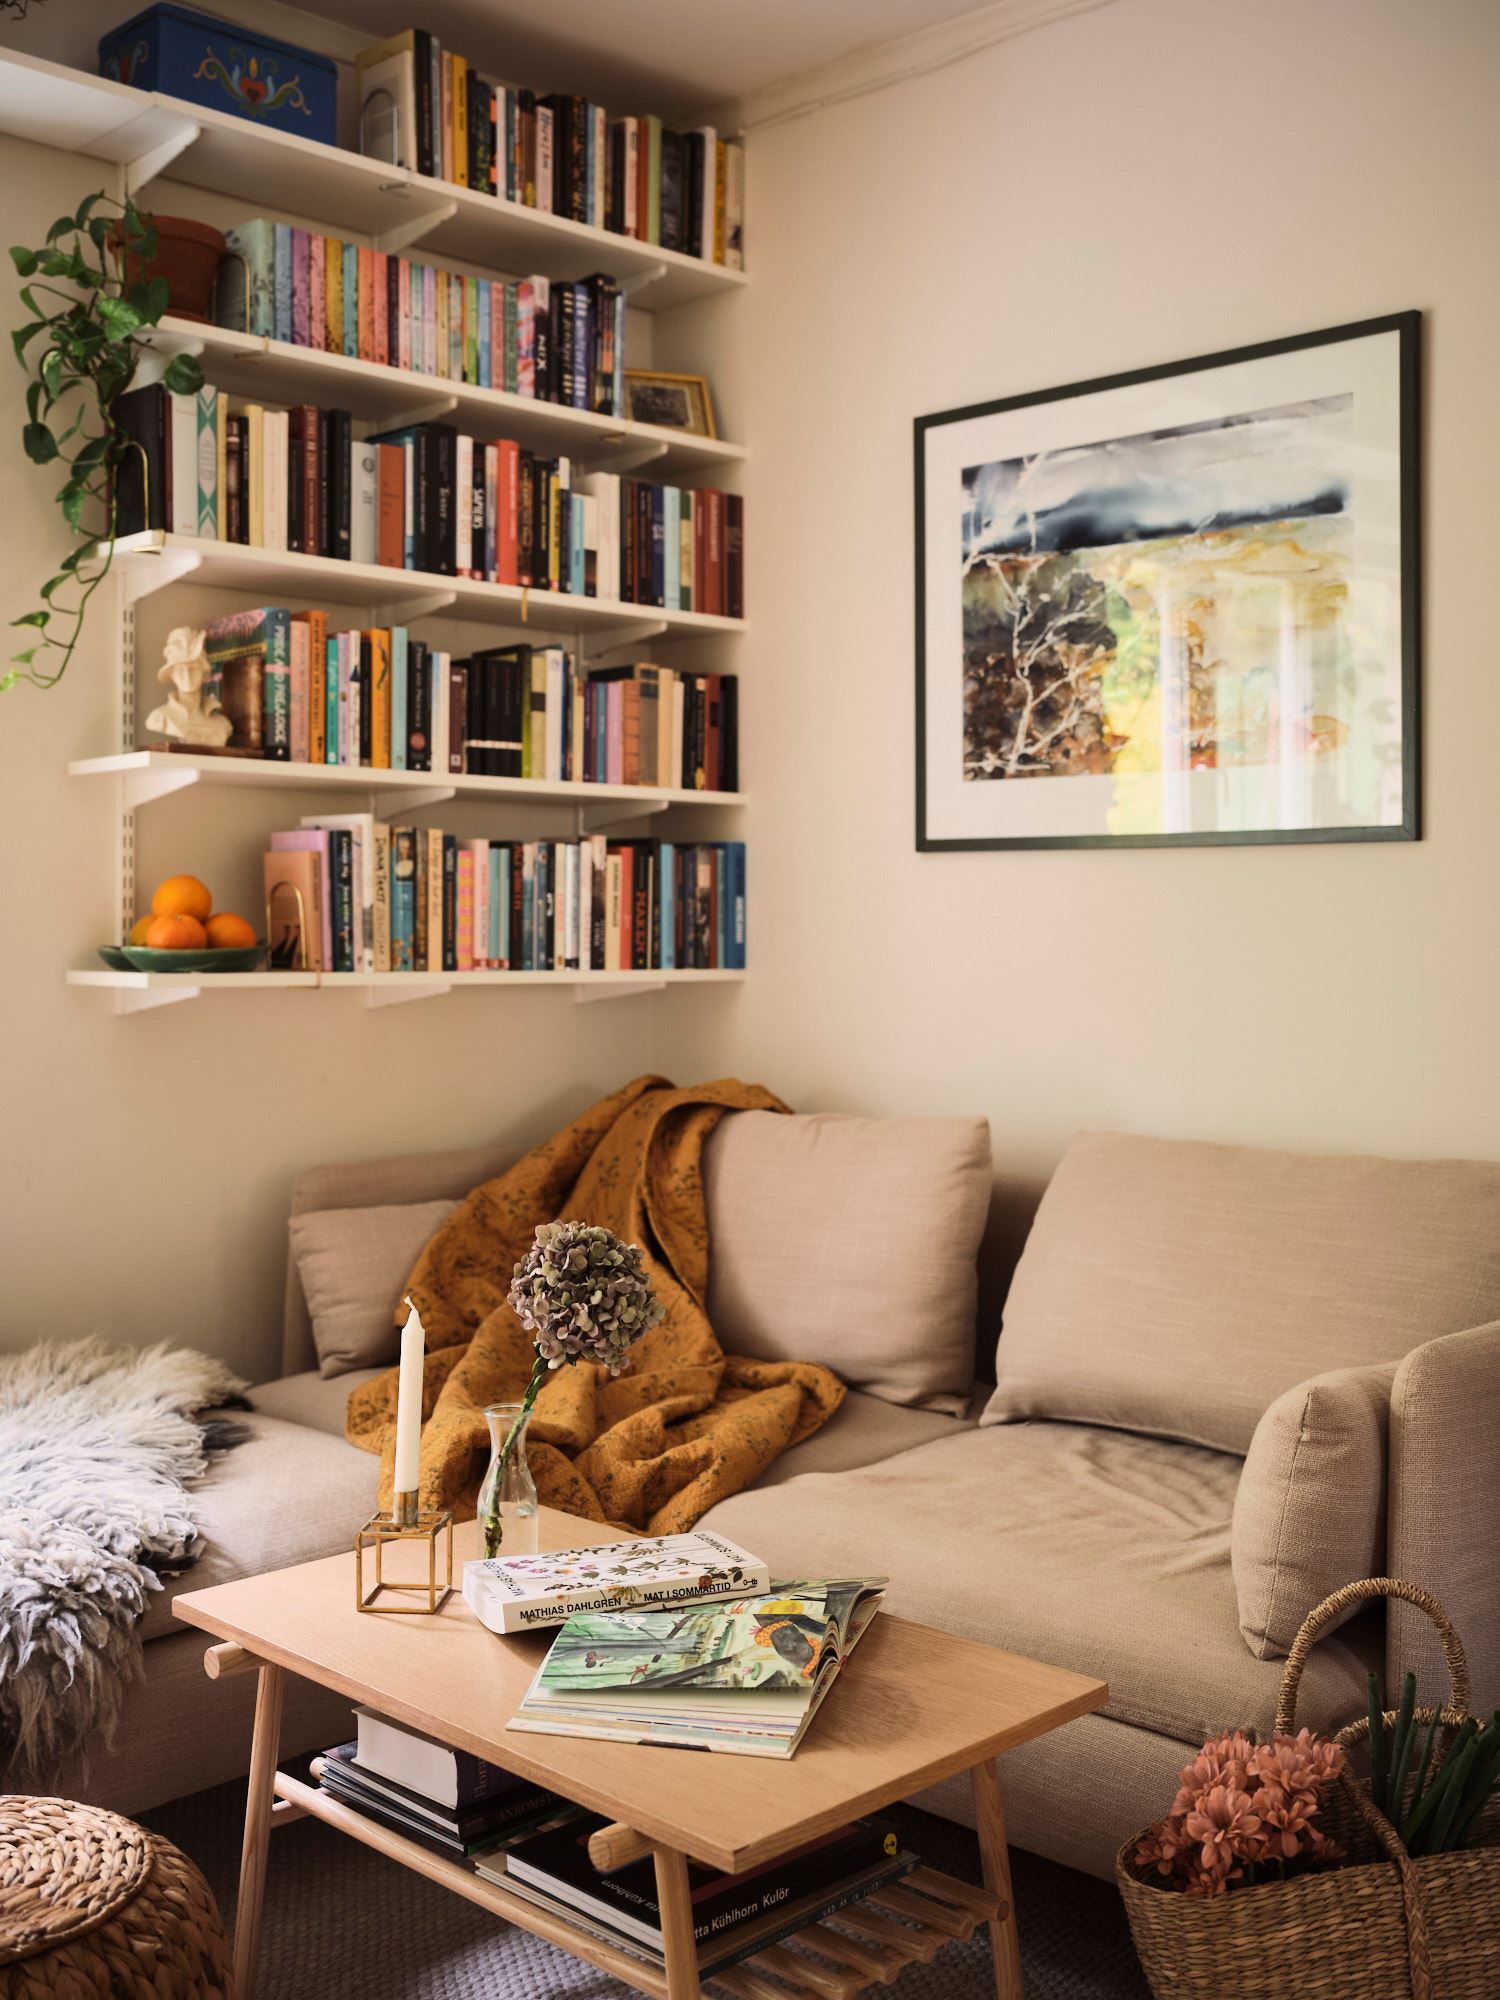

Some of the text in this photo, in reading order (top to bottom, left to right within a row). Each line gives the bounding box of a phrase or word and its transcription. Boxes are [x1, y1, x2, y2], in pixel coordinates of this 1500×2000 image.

[273, 624, 287, 743] PRIDE AND PREJUDICE
[520, 1581, 731, 1620] MATHIAS DAHLGREN MAT I SOMMARTID
[601, 1879, 646, 1905] Kühlhorn
[694, 1887, 790, 1939] tta Kühlhorn Kulör
